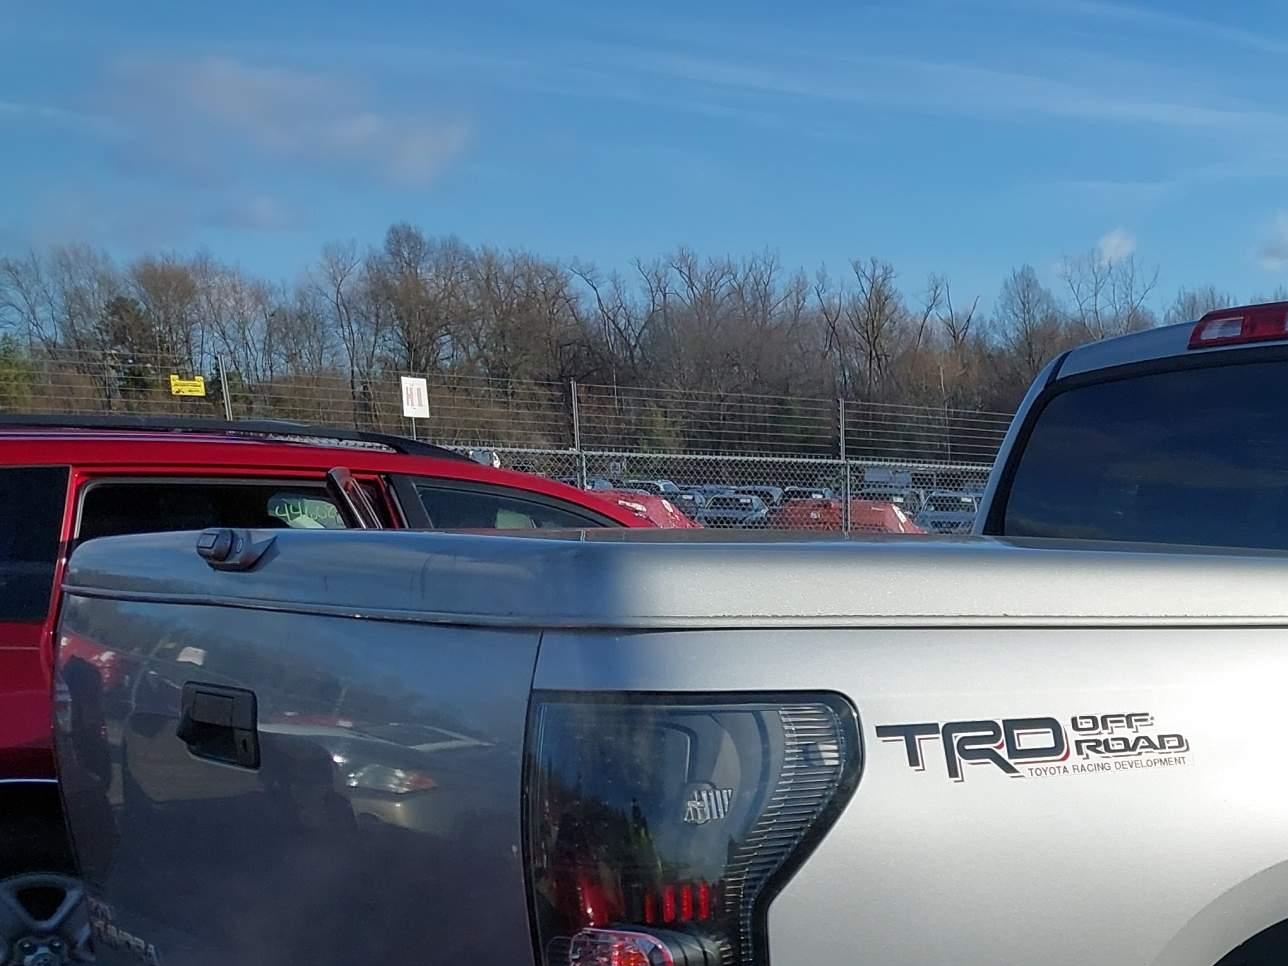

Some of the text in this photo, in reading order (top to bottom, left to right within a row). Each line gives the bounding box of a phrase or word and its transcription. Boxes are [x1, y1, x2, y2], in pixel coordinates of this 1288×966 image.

[1071, 712, 1154, 735] OFF
[875, 716, 1070, 783] TRD
[1074, 734, 1190, 760] ROAD
[1028, 756, 1187, 777] TOYOTA RACING DEVELOPMENT
